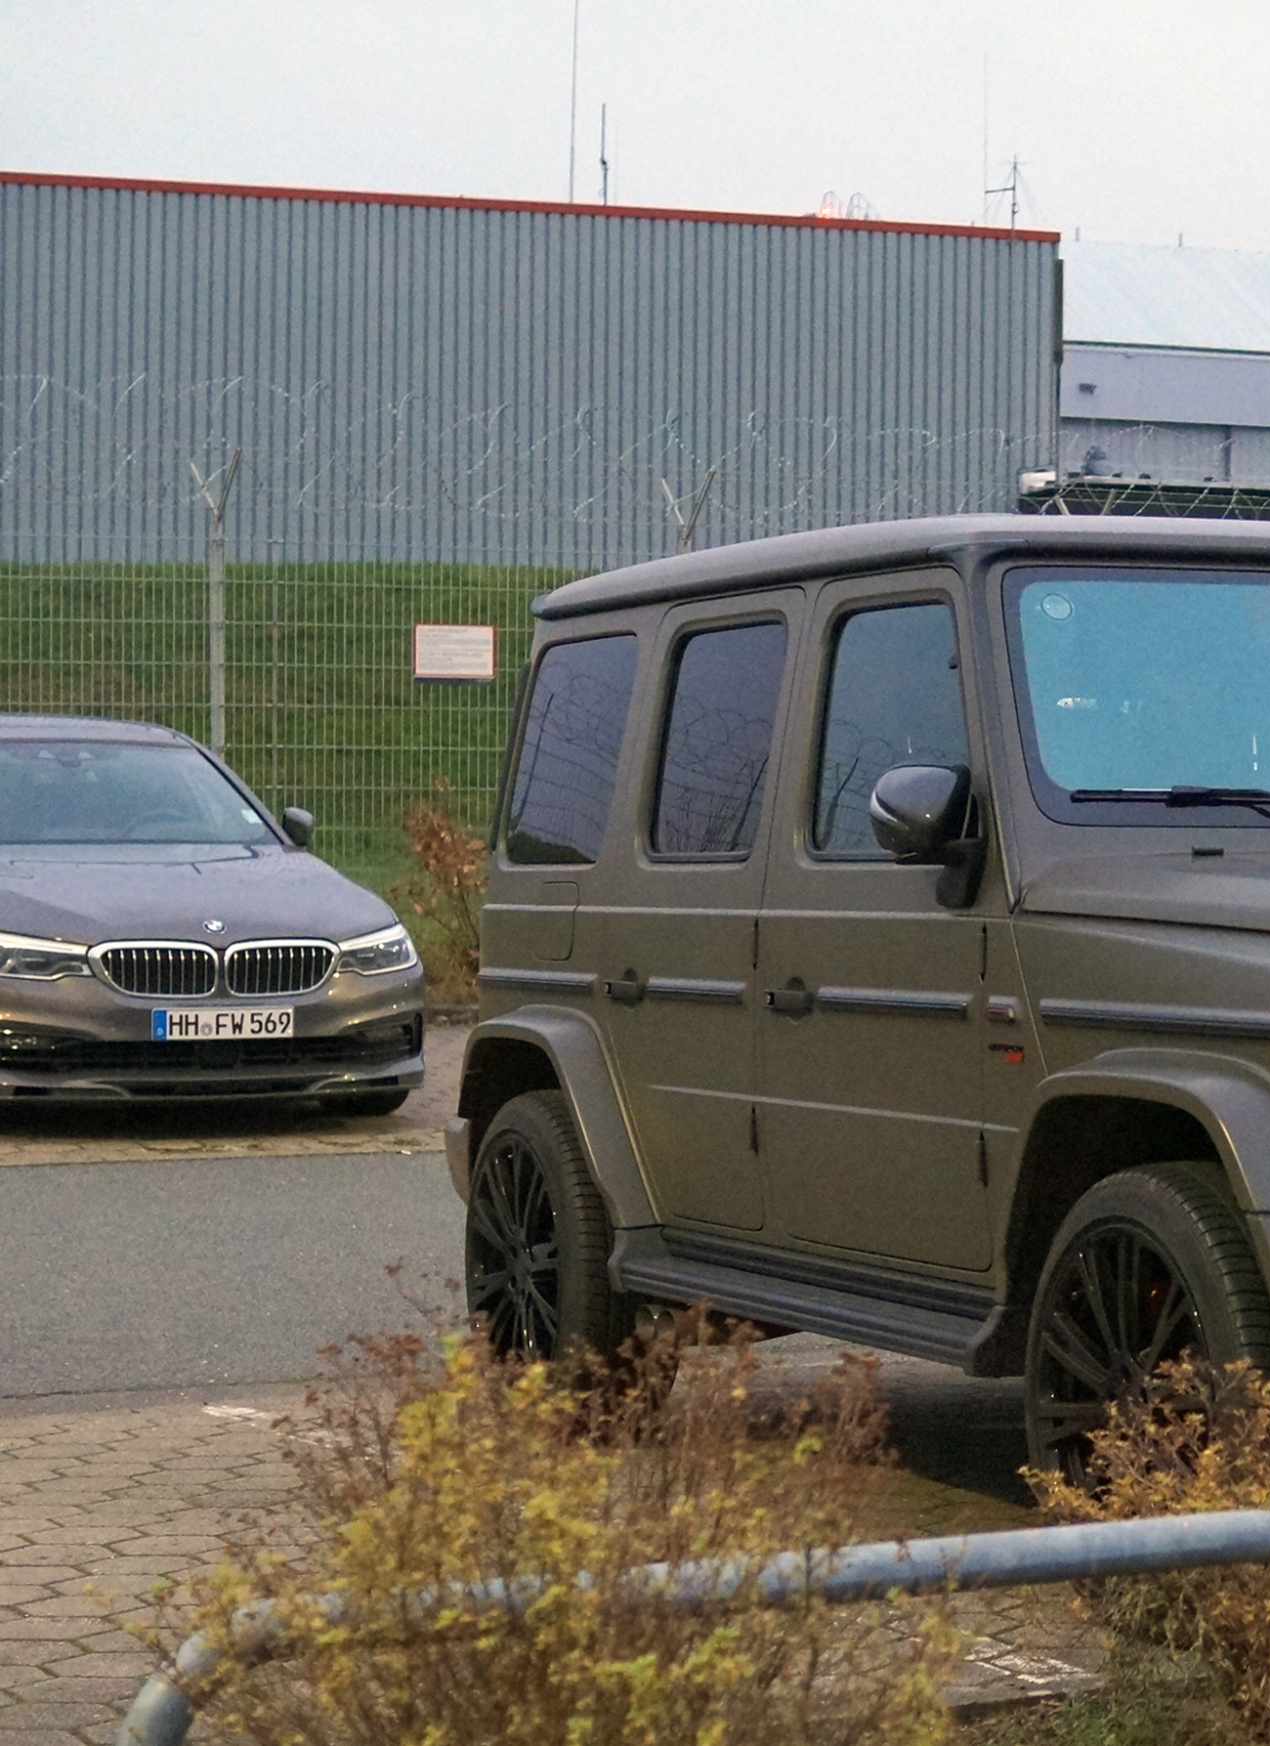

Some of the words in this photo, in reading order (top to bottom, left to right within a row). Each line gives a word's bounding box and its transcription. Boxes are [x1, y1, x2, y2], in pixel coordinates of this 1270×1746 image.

[169, 1014, 199, 1036] HH
[215, 1013, 244, 1035] FW
[250, 1012, 291, 1034] 569
